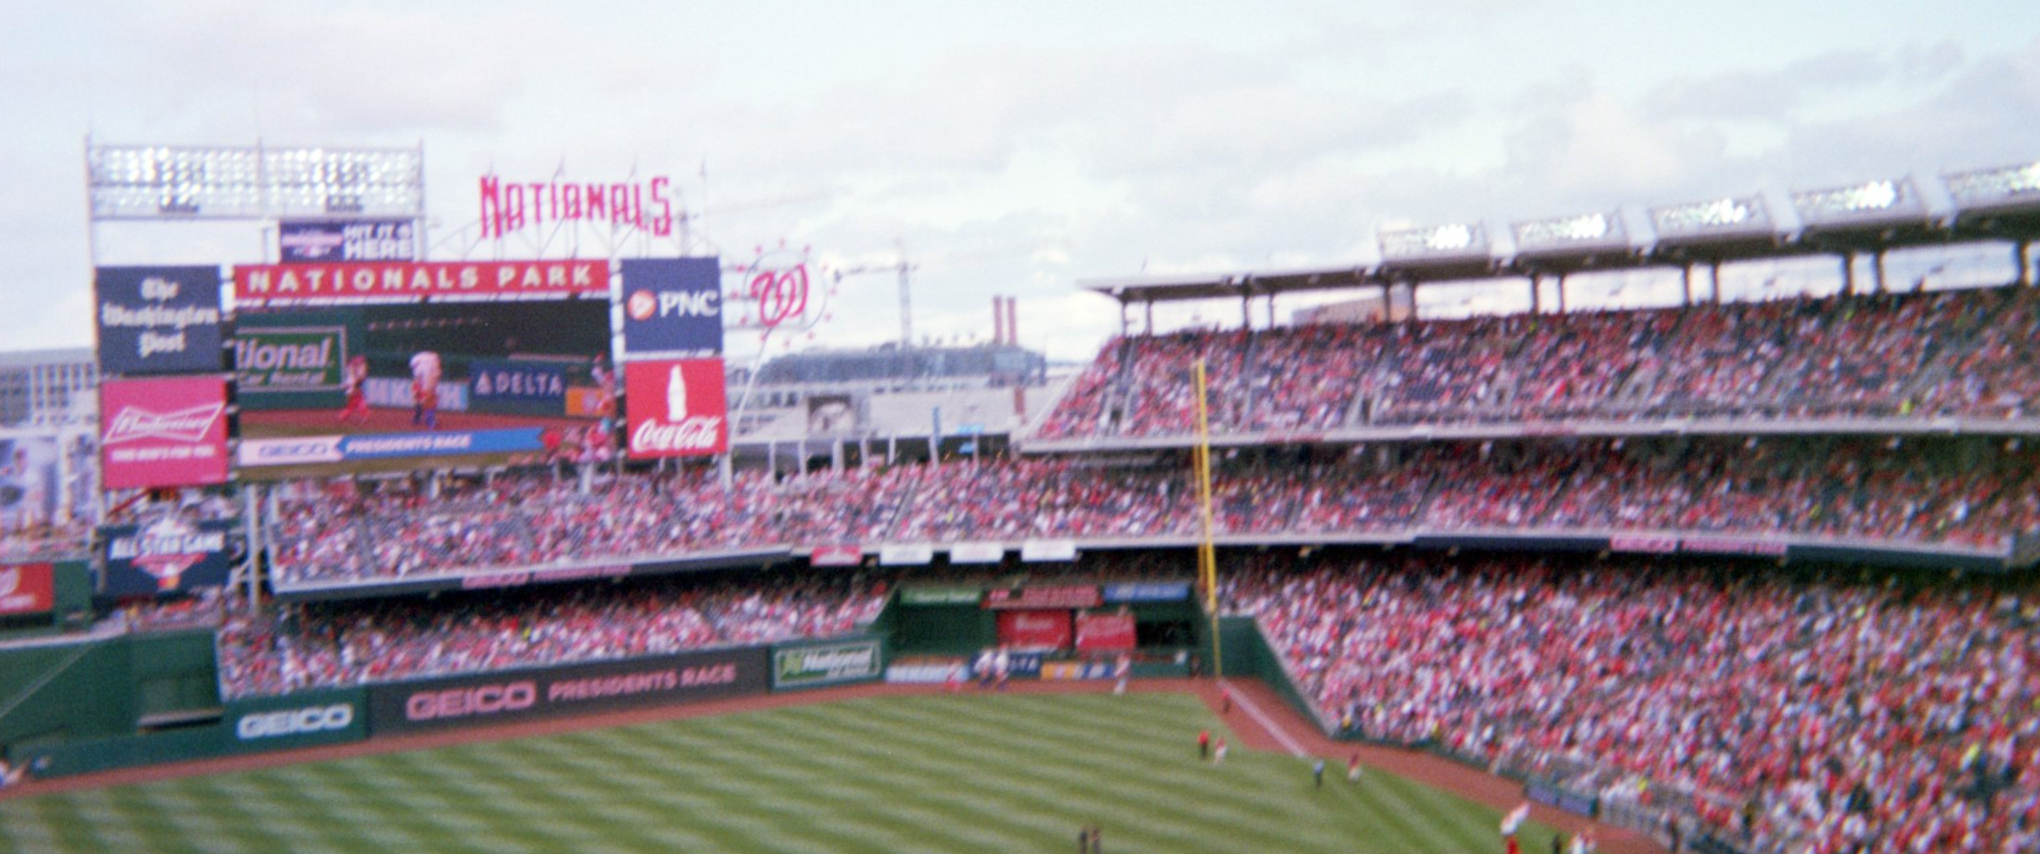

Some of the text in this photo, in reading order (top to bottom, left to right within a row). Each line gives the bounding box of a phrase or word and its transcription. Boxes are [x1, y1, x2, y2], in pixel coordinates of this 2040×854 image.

[480, 176, 672, 239] NATIONALS
[344, 223, 372, 241] HIT
[344, 240, 414, 261] HERE
[140, 277, 180, 304] The
[249, 264, 593, 293] NATIONALS PARK
[102, 302, 219, 331] Washington
[659, 289, 720, 317] PNC
[138, 330, 185, 358] Post
[496, 370, 564, 397] DELTA
[113, 412, 213, 435] Budweiser
[258, 442, 328, 457] GEICO
[406, 664, 737, 720] GEICO PRESIDENTS RACE
[237, 703, 353, 739] GEICO
